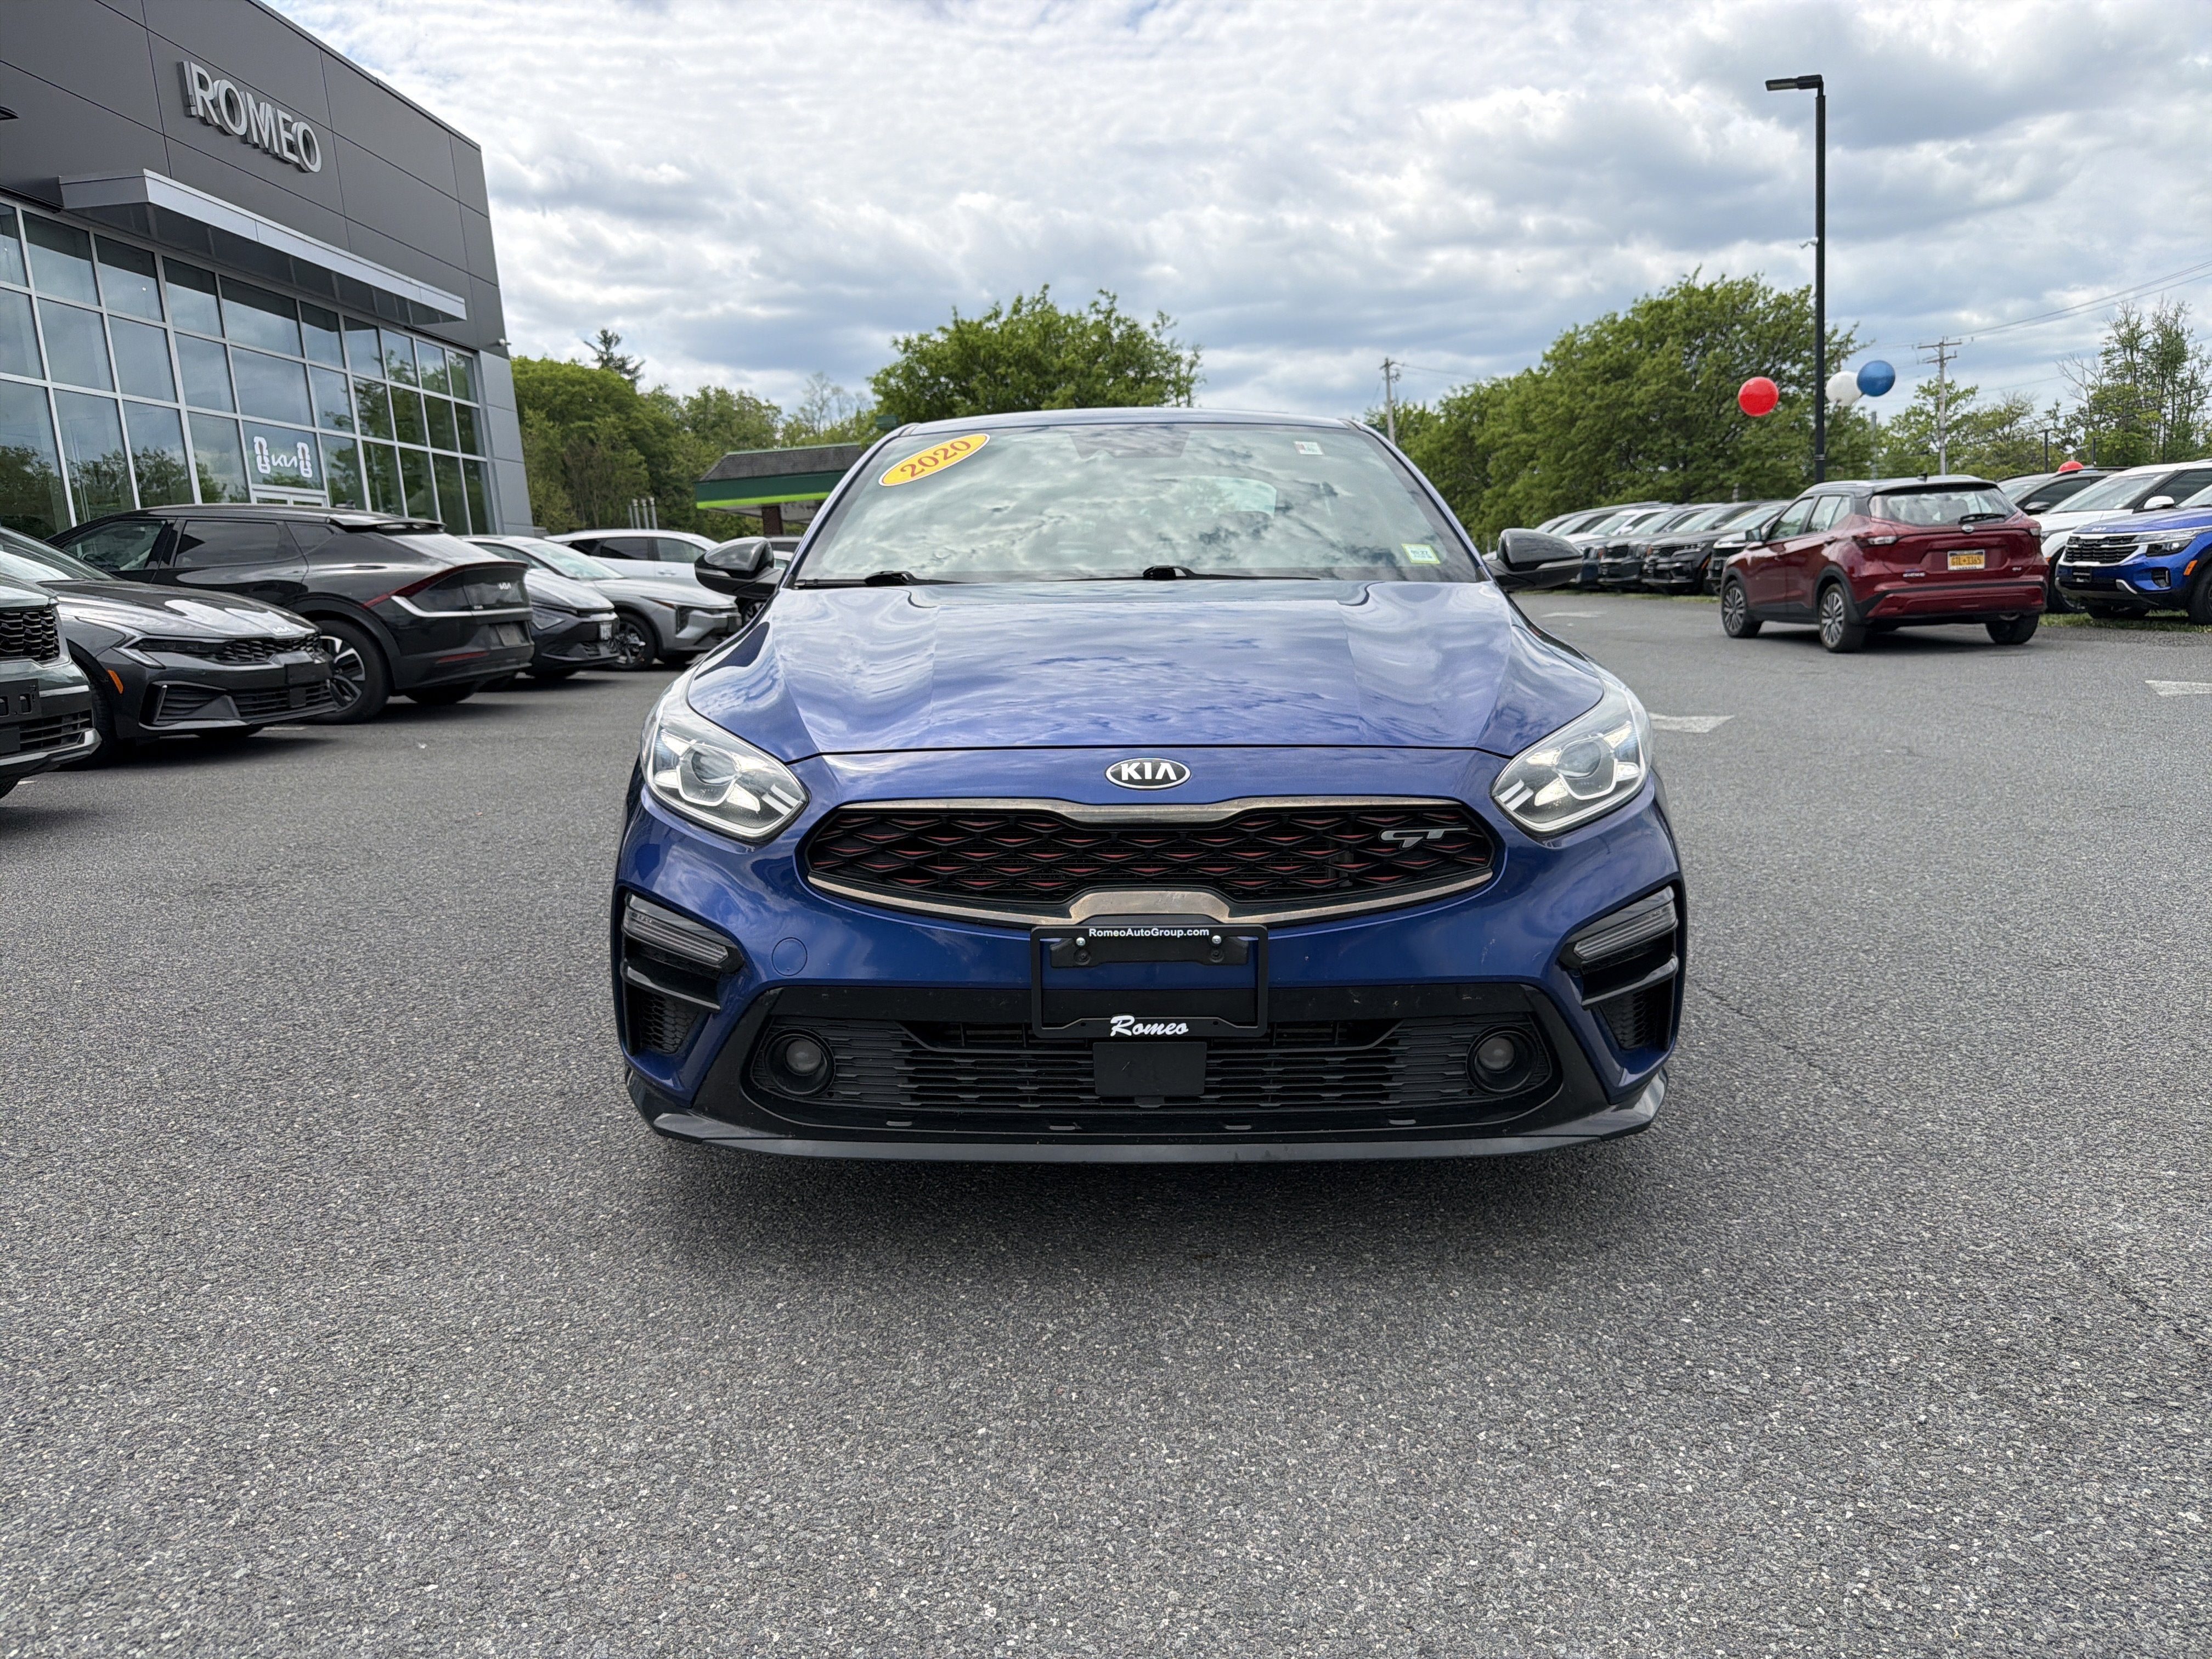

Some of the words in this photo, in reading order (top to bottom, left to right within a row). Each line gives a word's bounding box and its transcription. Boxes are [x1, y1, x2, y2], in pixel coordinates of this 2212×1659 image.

[185, 60, 322, 173] ROMEO
[900, 441, 971, 477] 2020
[1120, 762, 1177, 781] KIA
[1380, 827, 1469, 848] GT
[1088, 928, 1210, 938] RomeoAutoGroup.com
[1110, 1015, 1189, 1037] Romeo
